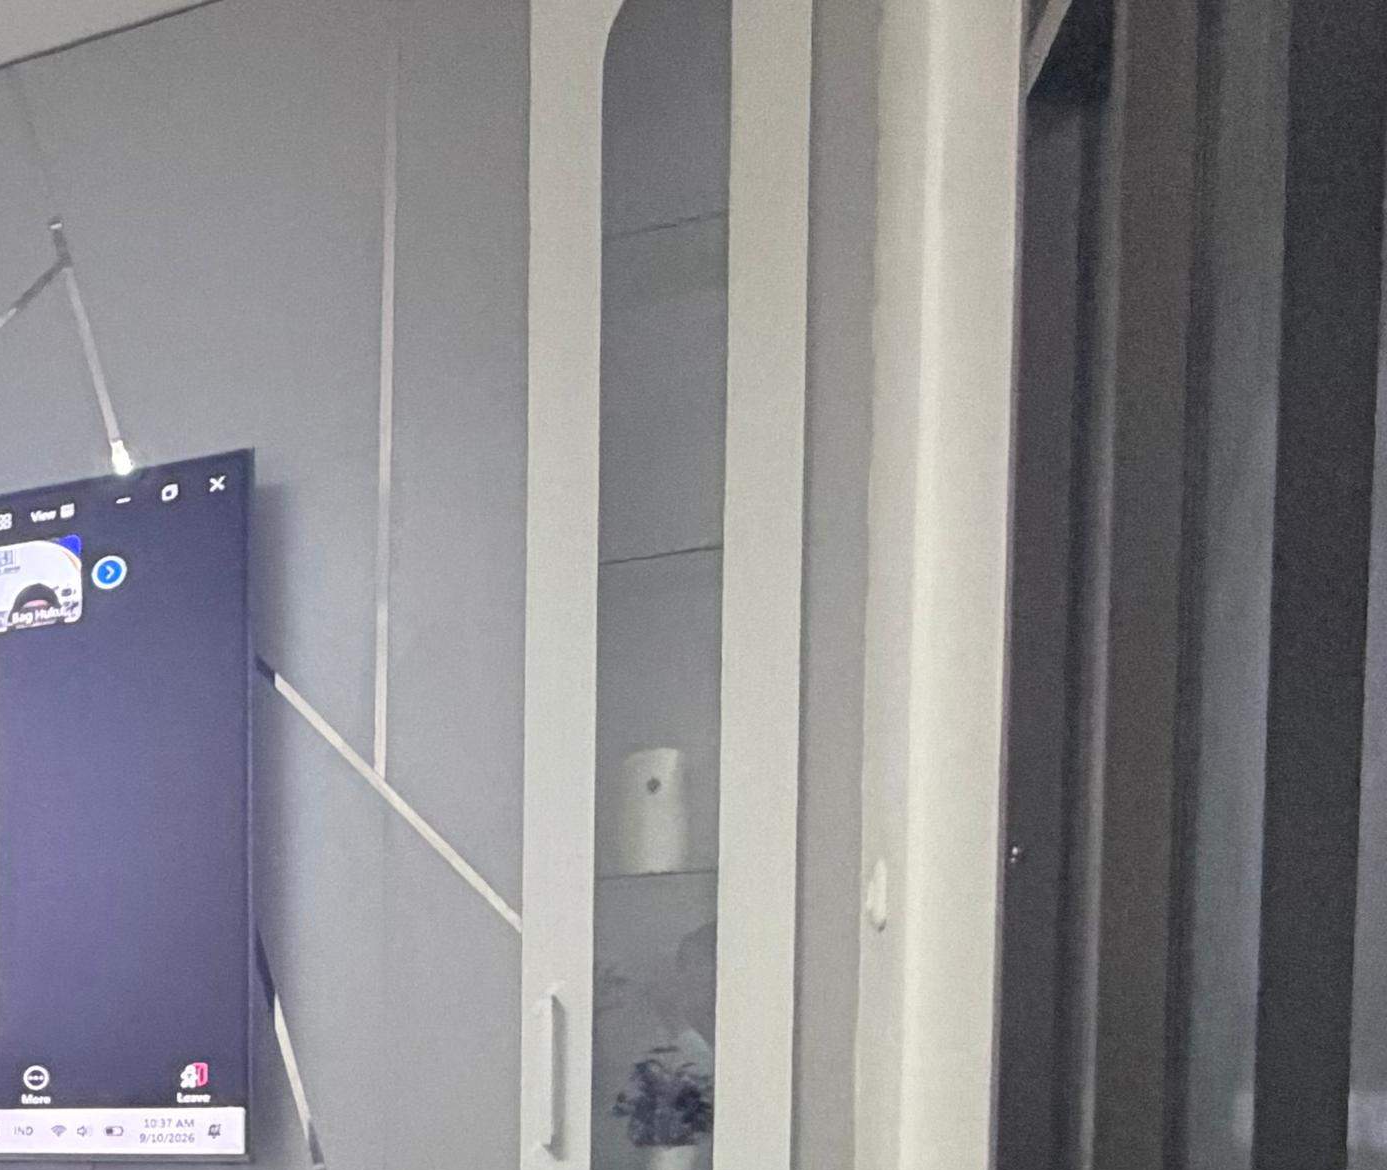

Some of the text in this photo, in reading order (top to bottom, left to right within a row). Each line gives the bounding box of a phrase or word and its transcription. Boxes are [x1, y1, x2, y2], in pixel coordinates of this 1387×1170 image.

[31, 509, 56, 523] View
[21, 1094, 51, 1105] More
[177, 1092, 211, 1103] Leave
[144, 1118, 195, 1130] 10:37 AM
[14, 1126, 33, 1136] IND
[139, 1132, 196, 1144] 9/10/2026
